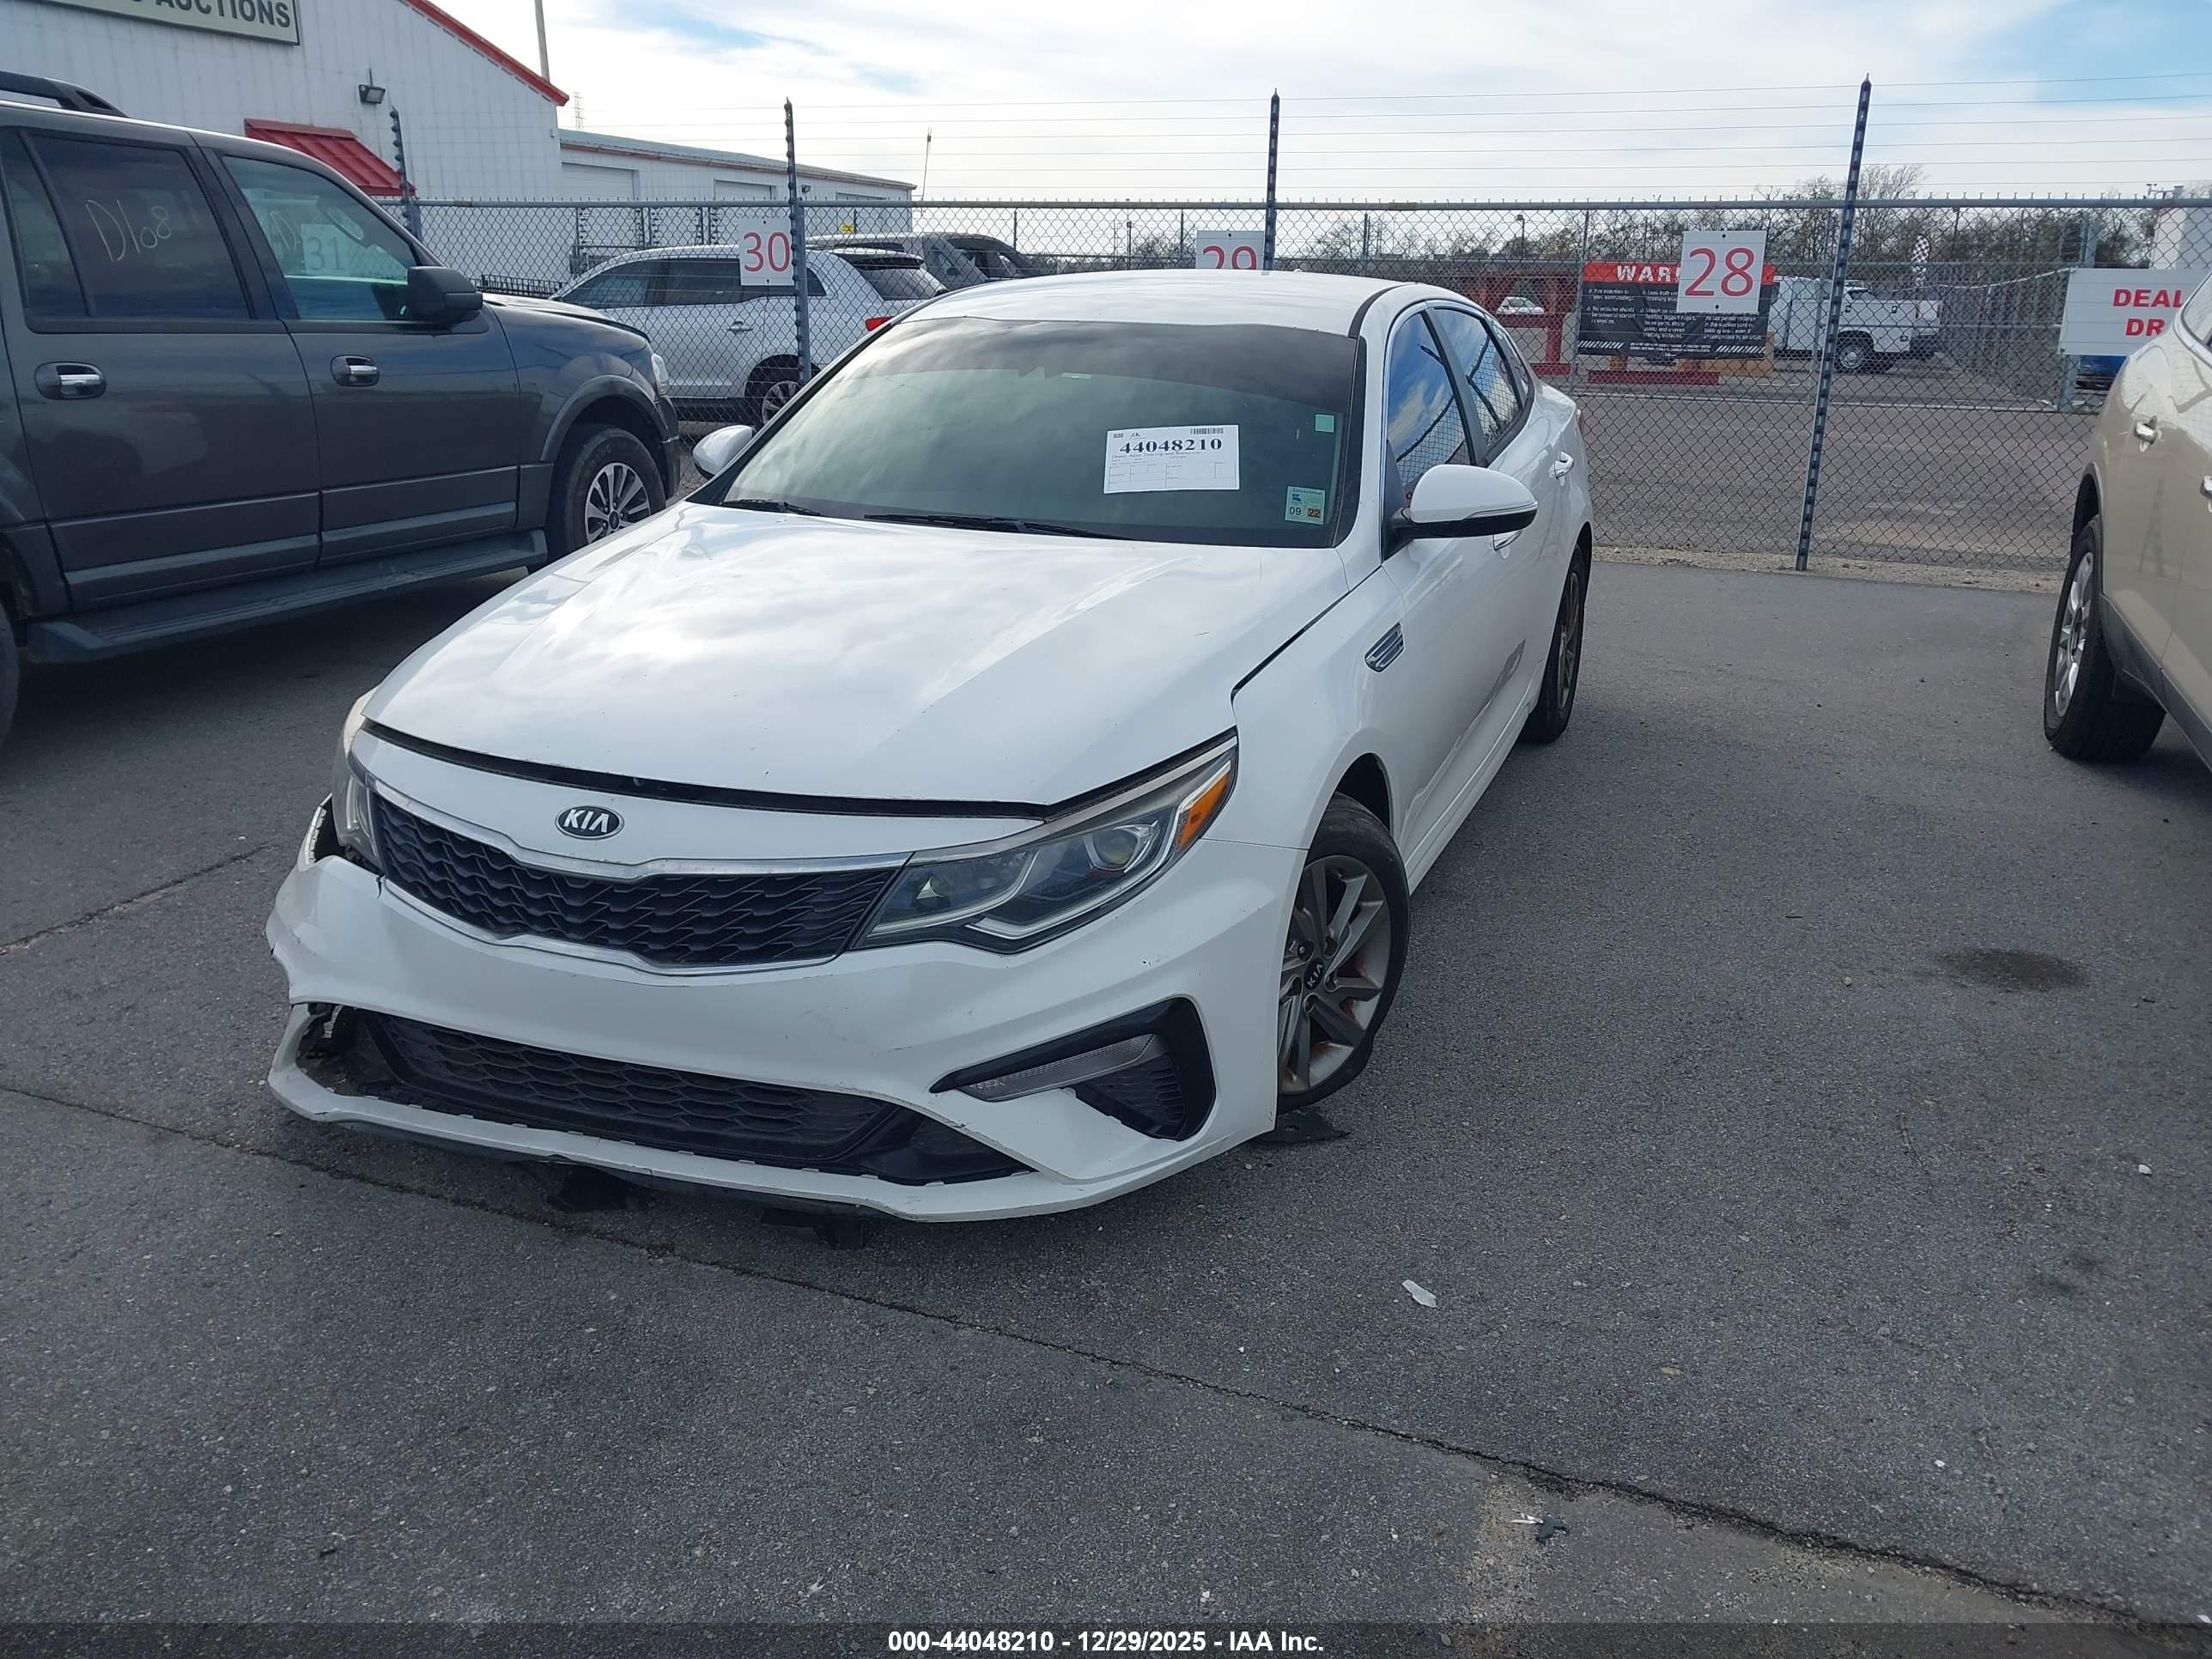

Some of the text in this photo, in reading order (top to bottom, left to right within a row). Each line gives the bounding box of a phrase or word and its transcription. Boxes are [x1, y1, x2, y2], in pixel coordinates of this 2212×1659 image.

[307, 236, 345, 271] 31
[743, 232, 790, 272] 30
[1685, 247, 1755, 297] 28
[2112, 289, 2183, 307] DEAL
[2125, 319, 2166, 337] DR
[1119, 438, 1222, 453] 44048210
[563, 809, 610, 833] KIA
[1306, 963, 1323, 988] KIA
